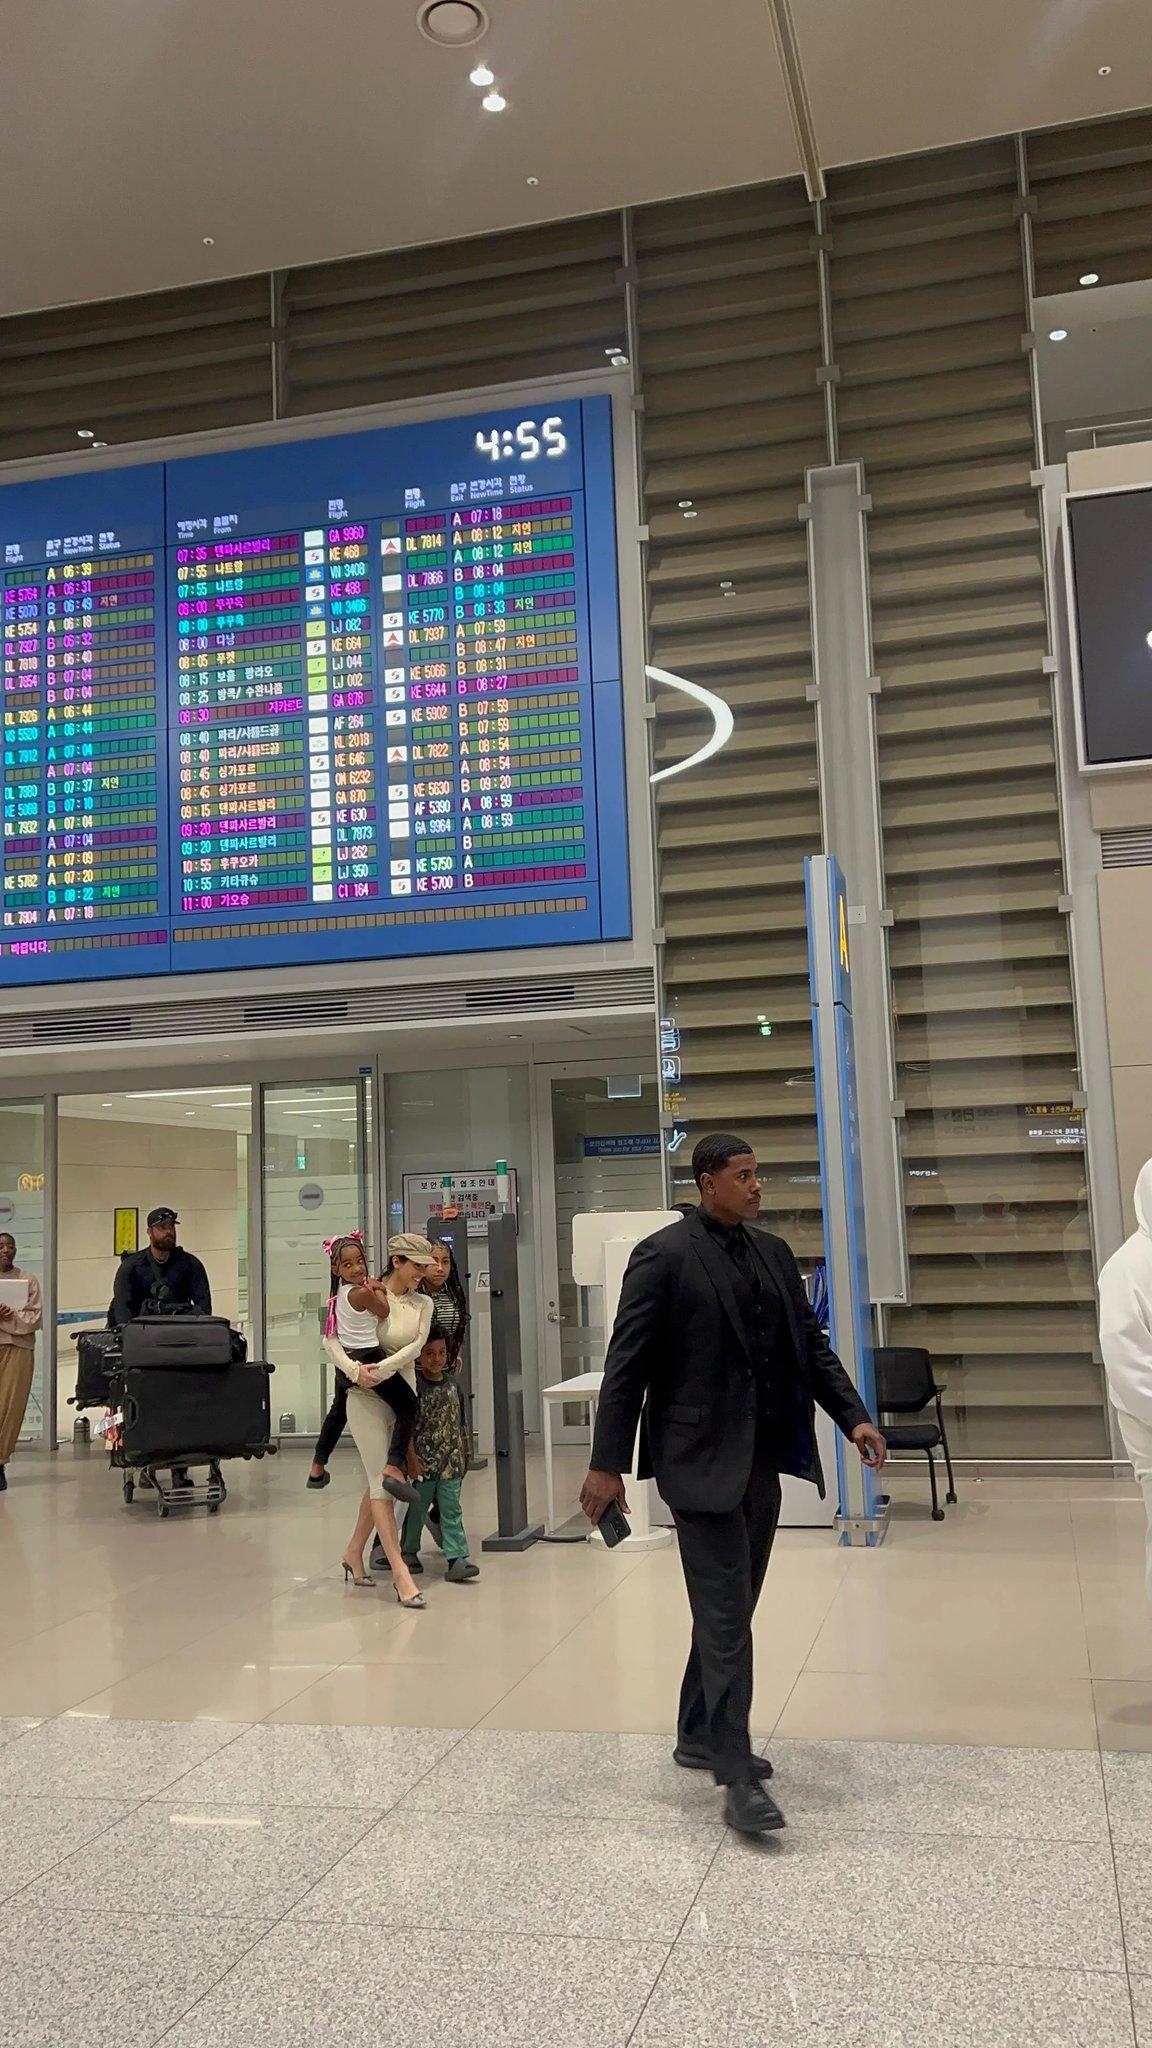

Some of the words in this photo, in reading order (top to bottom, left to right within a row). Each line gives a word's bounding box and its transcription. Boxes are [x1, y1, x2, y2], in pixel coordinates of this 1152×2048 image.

[476, 416, 566, 462] 4:55
[329, 510, 348, 520] Flight
[405, 500, 425, 509] Flight
[470, 489, 503, 499] NewTime
[510, 484, 533, 494] Status
[453, 512, 462, 526] A
[471, 507, 502, 524] 07:18
[453, 531, 462, 545] A
[471, 526, 502, 542] 08:12
[512, 521, 531, 536] 지연
[454, 550, 462, 563] A
[472, 544, 503, 561] 08:12
[513, 540, 532, 554] 지연
[47, 568, 55, 580] A
[408, 574, 418, 587] DL
[454, 568, 463, 582] B
[473, 563, 504, 579] 08:04
[47, 585, 55, 598] A
[455, 587, 464, 600] B
[47, 602, 56, 615] B
[47, 620, 56, 632] A
[216, 633, 235, 646] 다낭
[332, 620, 342, 633] LJ
[409, 610, 420, 624] KE
[423, 609, 444, 623] 5770
[456, 606, 464, 619] B
[474, 600, 505, 616] 08:33
[515, 596, 534, 610] 지연
[456, 624, 465, 638] A
[474, 619, 505, 635] 07:59
[47, 637, 56, 650] B
[332, 657, 343, 670] LJ
[347, 655, 362, 668] 044
[457, 643, 465, 656] B
[475, 638, 506, 654] 08:47
[516, 634, 535, 648] 지연
[47, 654, 55, 668] B
[47, 672, 56, 685] B
[333, 676, 343, 689] LJ
[410, 666, 421, 680] KE
[457, 662, 466, 675] B
[476, 657, 506, 673] 08:31
[47, 690, 56, 703] B
[411, 686, 421, 699] KE
[426, 683, 446, 697] 5644
[458, 680, 467, 694] B
[477, 676, 507, 692] 08:27
[47, 708, 56, 720] A
[334, 717, 344, 730] AF
[412, 708, 422, 722] KE
[426, 705, 447, 720] 5902
[459, 703, 468, 717] B
[477, 698, 508, 715] 07:59
[48, 725, 56, 738] A
[349, 733, 369, 747] 2018
[459, 722, 468, 736] B
[478, 718, 509, 734] 07:59
[48, 747, 56, 760] A
[219, 764, 256, 778] 싱가포르
[413, 746, 423, 759] DL
[460, 741, 469, 755] A
[479, 737, 510, 753] 08:54
[47, 765, 56, 778] A
[219, 782, 256, 796] 싱가포르
[350, 770, 370, 784] 6232
[461, 760, 470, 774] A
[479, 756, 510, 772] 08:54
[47, 783, 56, 796] B
[64, 779, 93, 794] 07:37
[219, 797, 276, 814] 덴파사르발리
[351, 789, 366, 802] 870
[414, 783, 425, 797] KE
[461, 779, 470, 792] B
[480, 775, 511, 790] 09:20
[48, 801, 56, 814] B
[219, 816, 277, 833] 덴파사르발리
[337, 810, 347, 823] KE
[351, 808, 367, 821] 630
[415, 802, 425, 816] AF
[429, 800, 450, 814] 5390
[462, 798, 471, 812] A
[481, 794, 512, 809] 08:59
[47, 819, 56, 832] A
[220, 835, 277, 852] 덴파사르발리
[337, 829, 348, 842] DL
[352, 826, 372, 840] 7873
[415, 821, 426, 835] GA
[463, 817, 472, 831] A
[482, 813, 513, 828] 08:59
[48, 837, 56, 850] A
[48, 855, 56, 868] A
[183, 859, 212, 874] 10:55
[220, 855, 258, 870] 후쿠오카
[337, 848, 348, 860] LJ
[463, 836, 472, 849] B
[48, 873, 56, 886] A
[64, 870, 94, 884] 07:20
[183, 877, 212, 892] 10:55
[220, 874, 258, 888] 키타큐슈
[338, 866, 349, 879] LJ
[352, 864, 368, 878] 350
[416, 859, 427, 872] KE
[431, 857, 452, 871] 5750
[464, 855, 473, 869] A
[48, 891, 56, 904] B
[183, 896, 212, 910] 11:00
[221, 894, 249, 906] 가오슝
[339, 885, 348, 897] CI
[354, 883, 369, 896] 164
[417, 878, 427, 891] KE
[432, 876, 453, 890] 5700
[464, 874, 473, 887] B
[48, 909, 56, 922] A
[64, 906, 94, 920] 07:18
